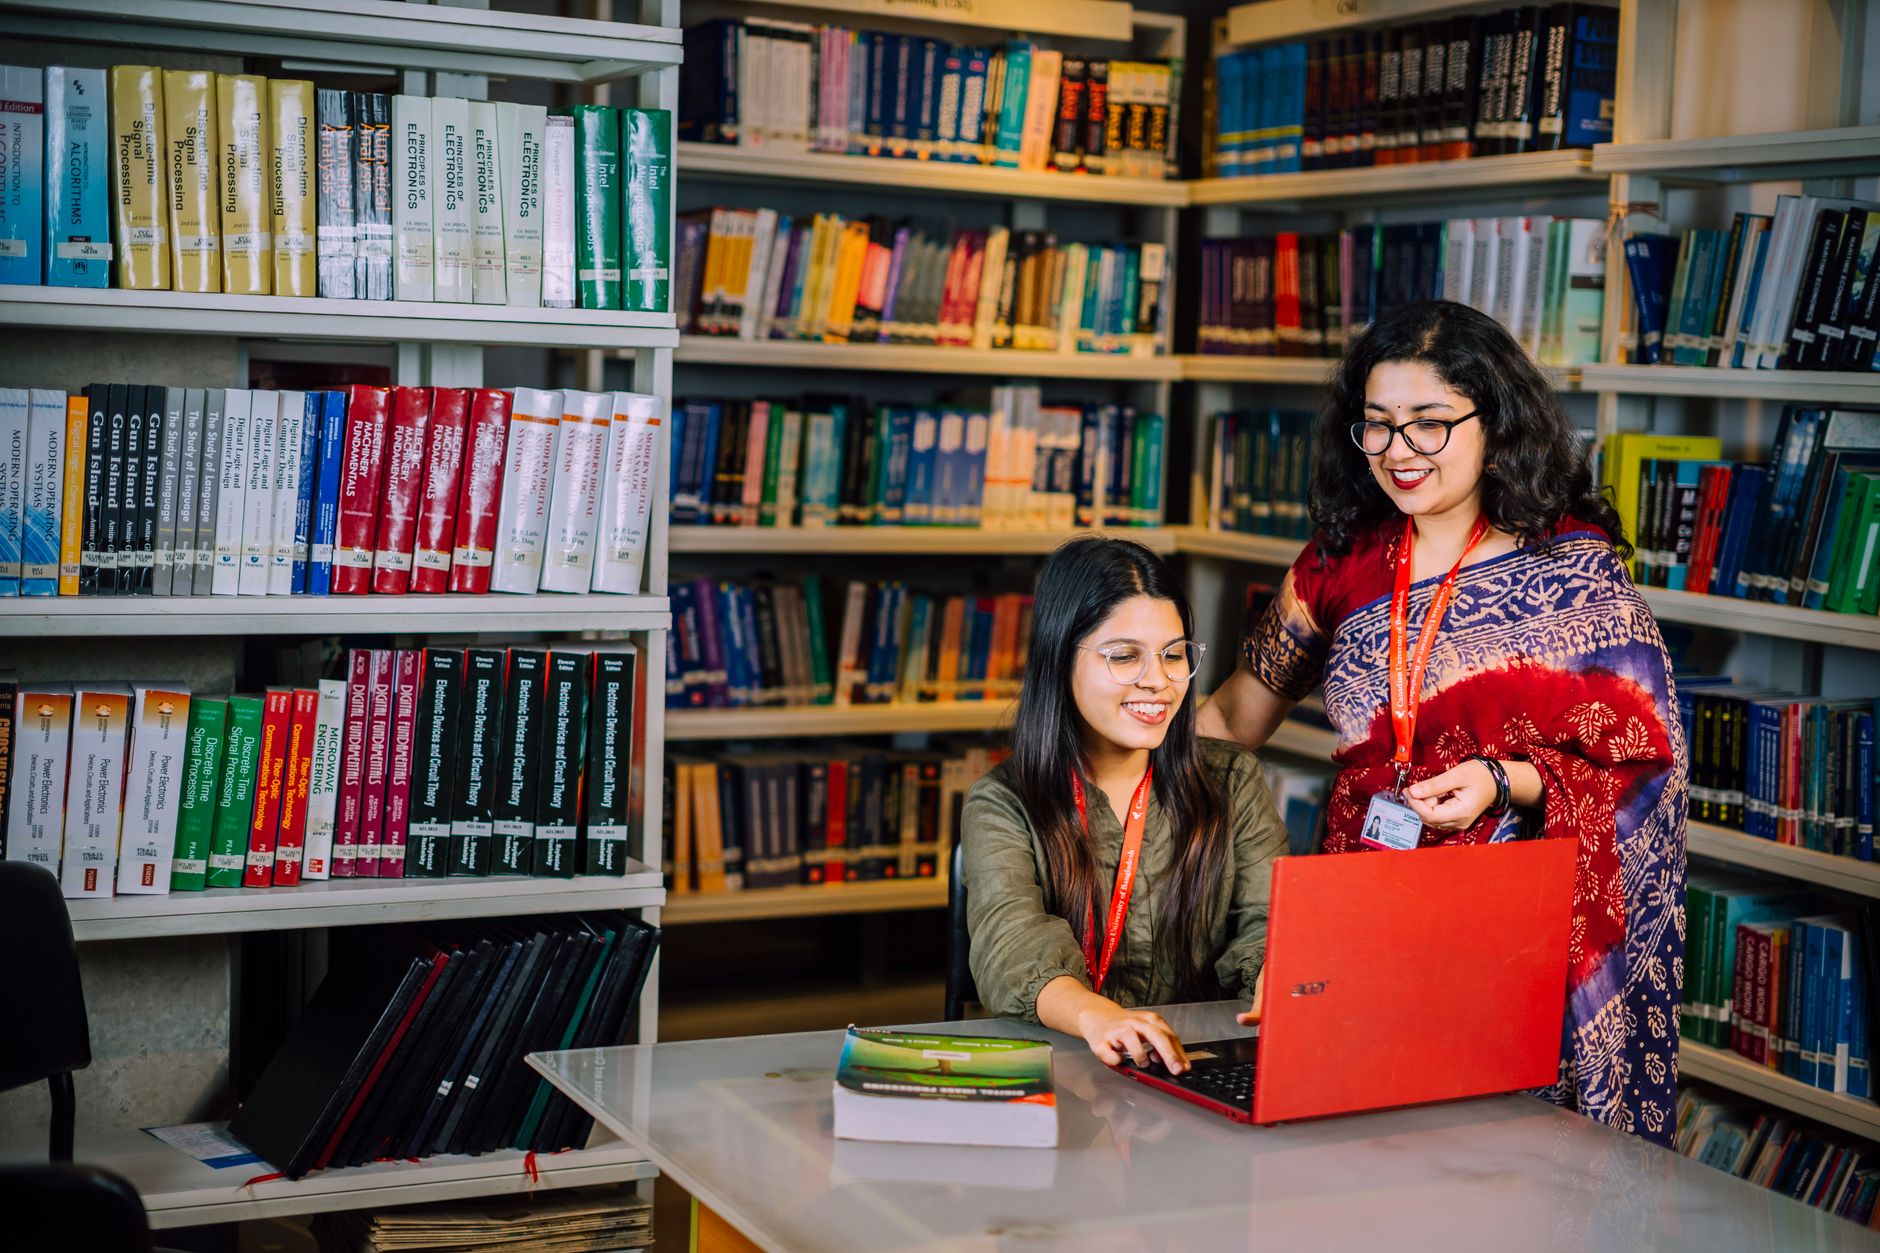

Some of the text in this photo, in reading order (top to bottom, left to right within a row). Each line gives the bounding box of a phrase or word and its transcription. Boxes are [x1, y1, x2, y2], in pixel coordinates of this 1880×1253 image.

[4, 102, 35, 113] Edition
[130, 120, 144, 160] Signal
[12, 122, 22, 206] INTRODUCTION TO
[120, 135, 132, 205] Processing
[173, 140, 186, 211] Processing
[183, 126, 197, 165] Signal
[198, 109, 210, 192] Discrete-time
[297, 116, 309, 197] Discrete-time
[318, 123, 337, 194] Analysis
[336, 124, 354, 213] Numerical
[357, 123, 376, 193] Analysis
[375, 124, 392, 212] Numerical
[407, 123, 418, 210] ELECTRONICS
[418, 134, 426, 201] PRINCIPLES OF
[445, 124, 456, 211] ELECTRONICS
[456, 135, 464, 202] PRINCIPLES OF
[475, 129, 488, 214] ELECTRONICS
[486, 139, 496, 205] PRINCIPLES OF
[519, 132, 532, 218] ELECTRONICS
[530, 143, 539, 209] PRINCIPLES OF
[599, 163, 609, 188] Intel
[649, 165, 660, 190] Intel
[70, 141, 82, 225] ALGORITHMS
[274, 147, 286, 216] Processing
[88, 411, 104, 506] Gun Island
[108, 413, 124, 508] Gun Island
[125, 414, 141, 509] Gun Island
[144, 413, 161, 507] Gun Island
[160, 411, 179, 523] The Study of Language
[181, 411, 199, 522] The Study of Language
[200, 412, 219, 523] The Study of Language
[222, 416, 236, 489] Computer Design
[233, 417, 246, 489] Digital Logic and
[250, 417, 263, 490] Computer Design
[261, 418, 274, 490] Digital Logic and
[346, 420, 363, 497] FUNDAMENTALS
[359, 421, 373, 478] MACHINERY
[371, 422, 383, 465] ELECTRIC
[388, 425, 404, 501] FUNDAMENTALS
[400, 426, 414, 482] MACHINERY
[411, 427, 424, 470] ELECTRIC
[450, 426, 463, 469] ELECTRIC
[492, 425, 505, 466] ELECTRIC
[514, 428, 525, 473] SYSTEMS
[536, 431, 553, 518] MODERN DIGITAL
[8, 430, 21, 542] MODERN OPERATING
[33, 463, 44, 508] SYSTEMS
[44, 431, 58, 542] MODERN OPERATING
[1396, 626, 1403, 636] of
[1418, 617, 1437, 657] University
[1431, 586, 1448, 619] Canadian
[1396, 635, 1404, 669] University
[1415, 654, 1423, 664] of
[351, 684, 366, 717] DIGITAL
[374, 684, 389, 717] DIGITAL
[399, 684, 413, 717] DIGITAL
[183, 727, 205, 809] Signal Processing
[220, 726, 243, 808] Signal Processing
[254, 724, 276, 831] Communications Technology
[270, 757, 283, 799] Fiber-Optic
[281, 724, 303, 830] Communications Technology
[298, 757, 310, 799] Fiber-Optic
[313, 723, 328, 795] ENGINEERING
[324, 727, 339, 793] MICROWAVE
[424, 680, 448, 807] Electronic Devices and Circuit Theory
[600, 682, 619, 808] Electronic Devices and Circuit Theory
[39, 758, 54, 815] Power Electronics
[96, 758, 111, 814] Power Electronics
[143, 793, 152, 820] Applications
[156, 755, 172, 810] Power Electronics
[86, 870, 95, 889] PEARSON
[144, 865, 152, 885] PEARSON
[1110, 849, 1135, 937] University of Bangladesh
[1757, 941, 1769, 986] CARGO
